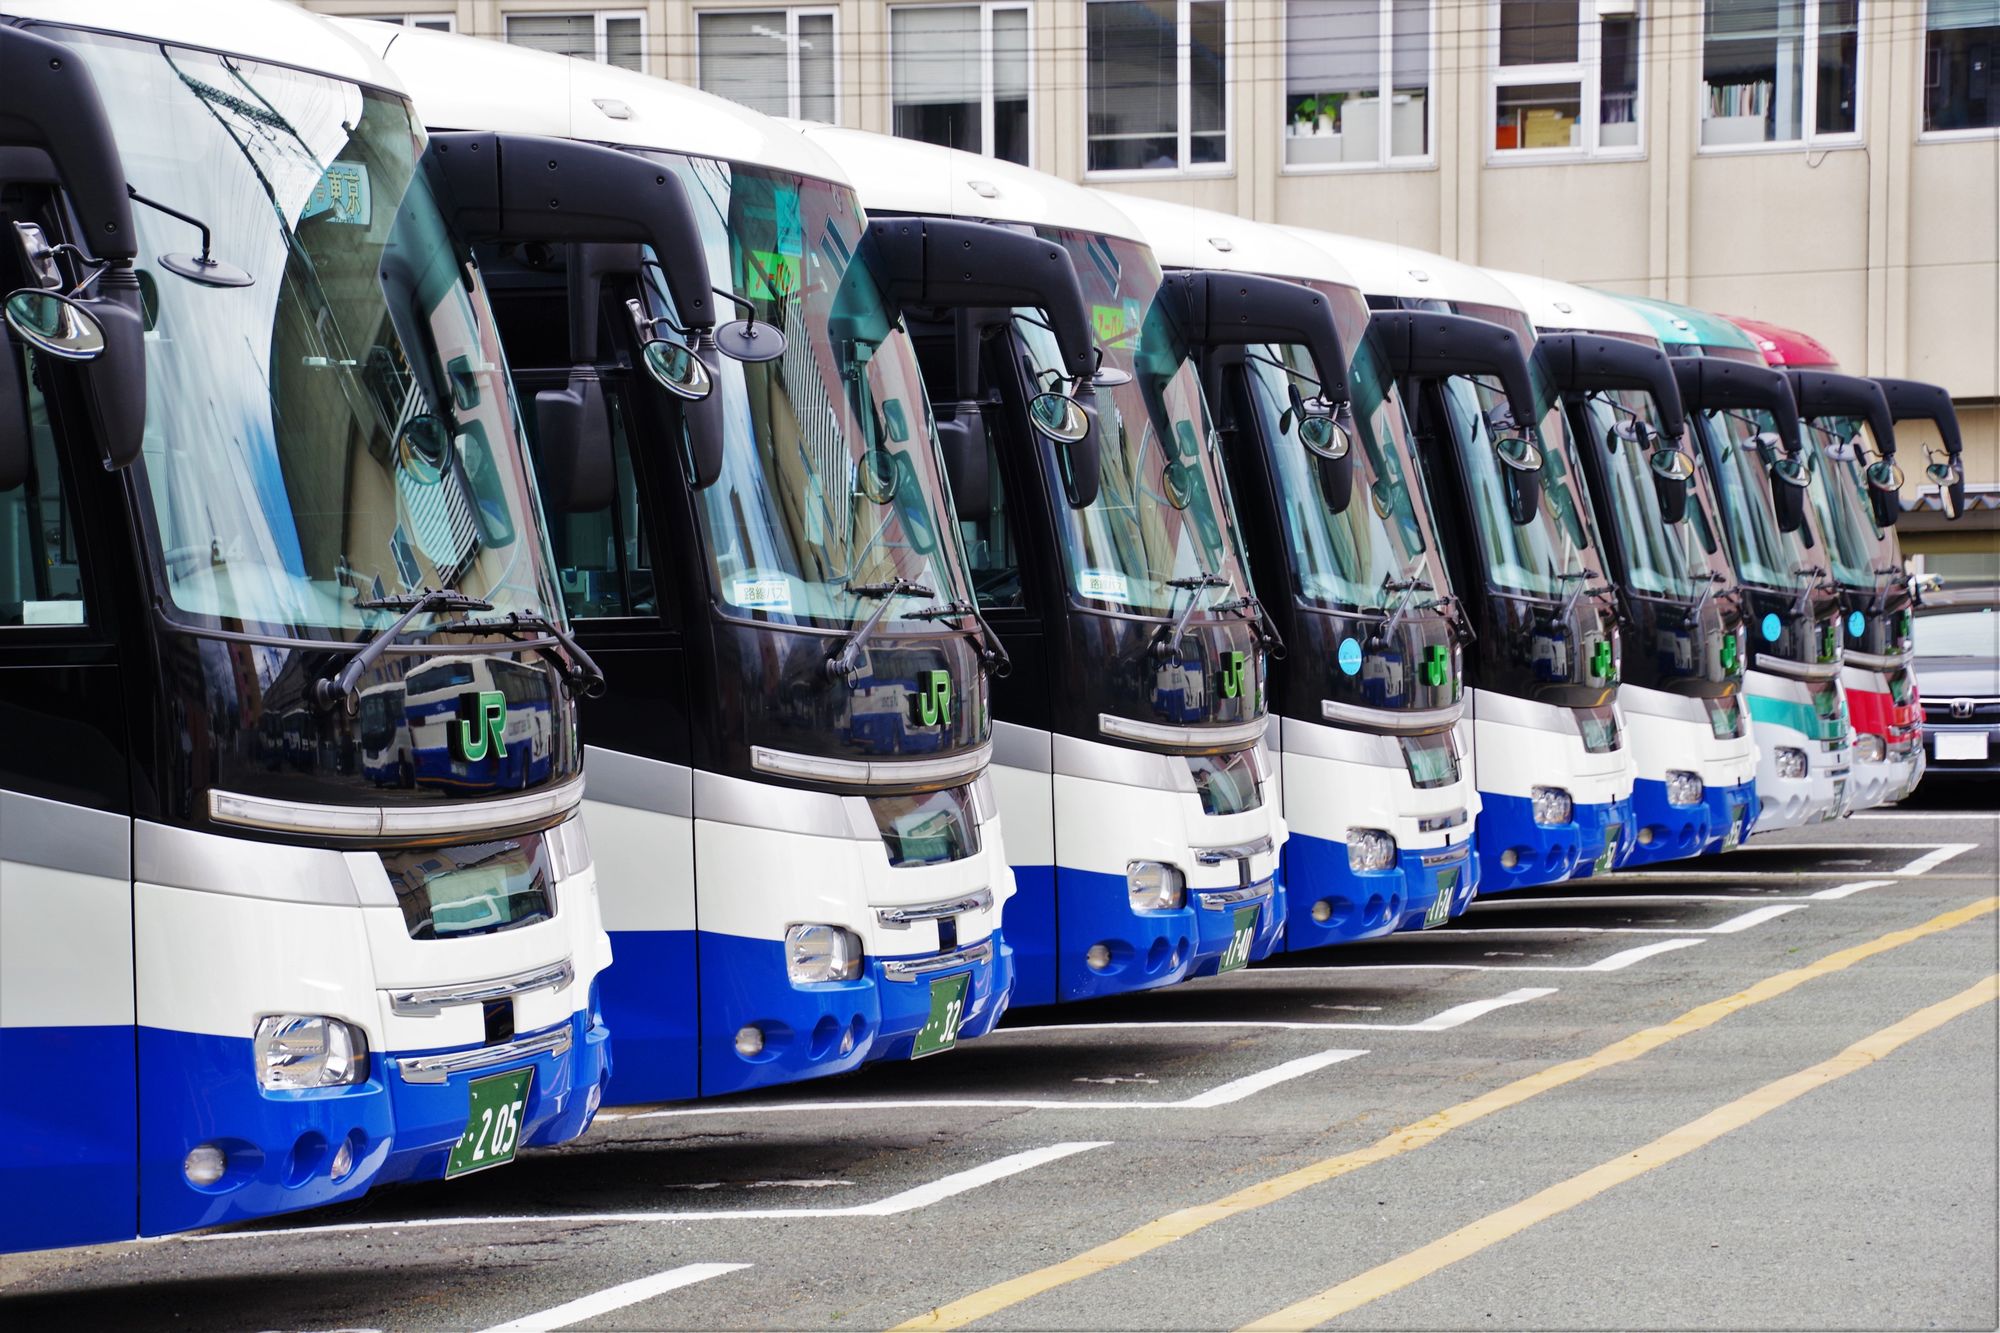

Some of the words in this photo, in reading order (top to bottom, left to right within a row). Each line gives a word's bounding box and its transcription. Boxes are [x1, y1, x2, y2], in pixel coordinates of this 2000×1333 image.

[326, 167, 361, 216] 東京
[1223, 650, 1246, 699] JR
[1427, 644, 1449, 687] JR
[919, 669, 952, 727] JR
[462, 690, 508, 762] JR
